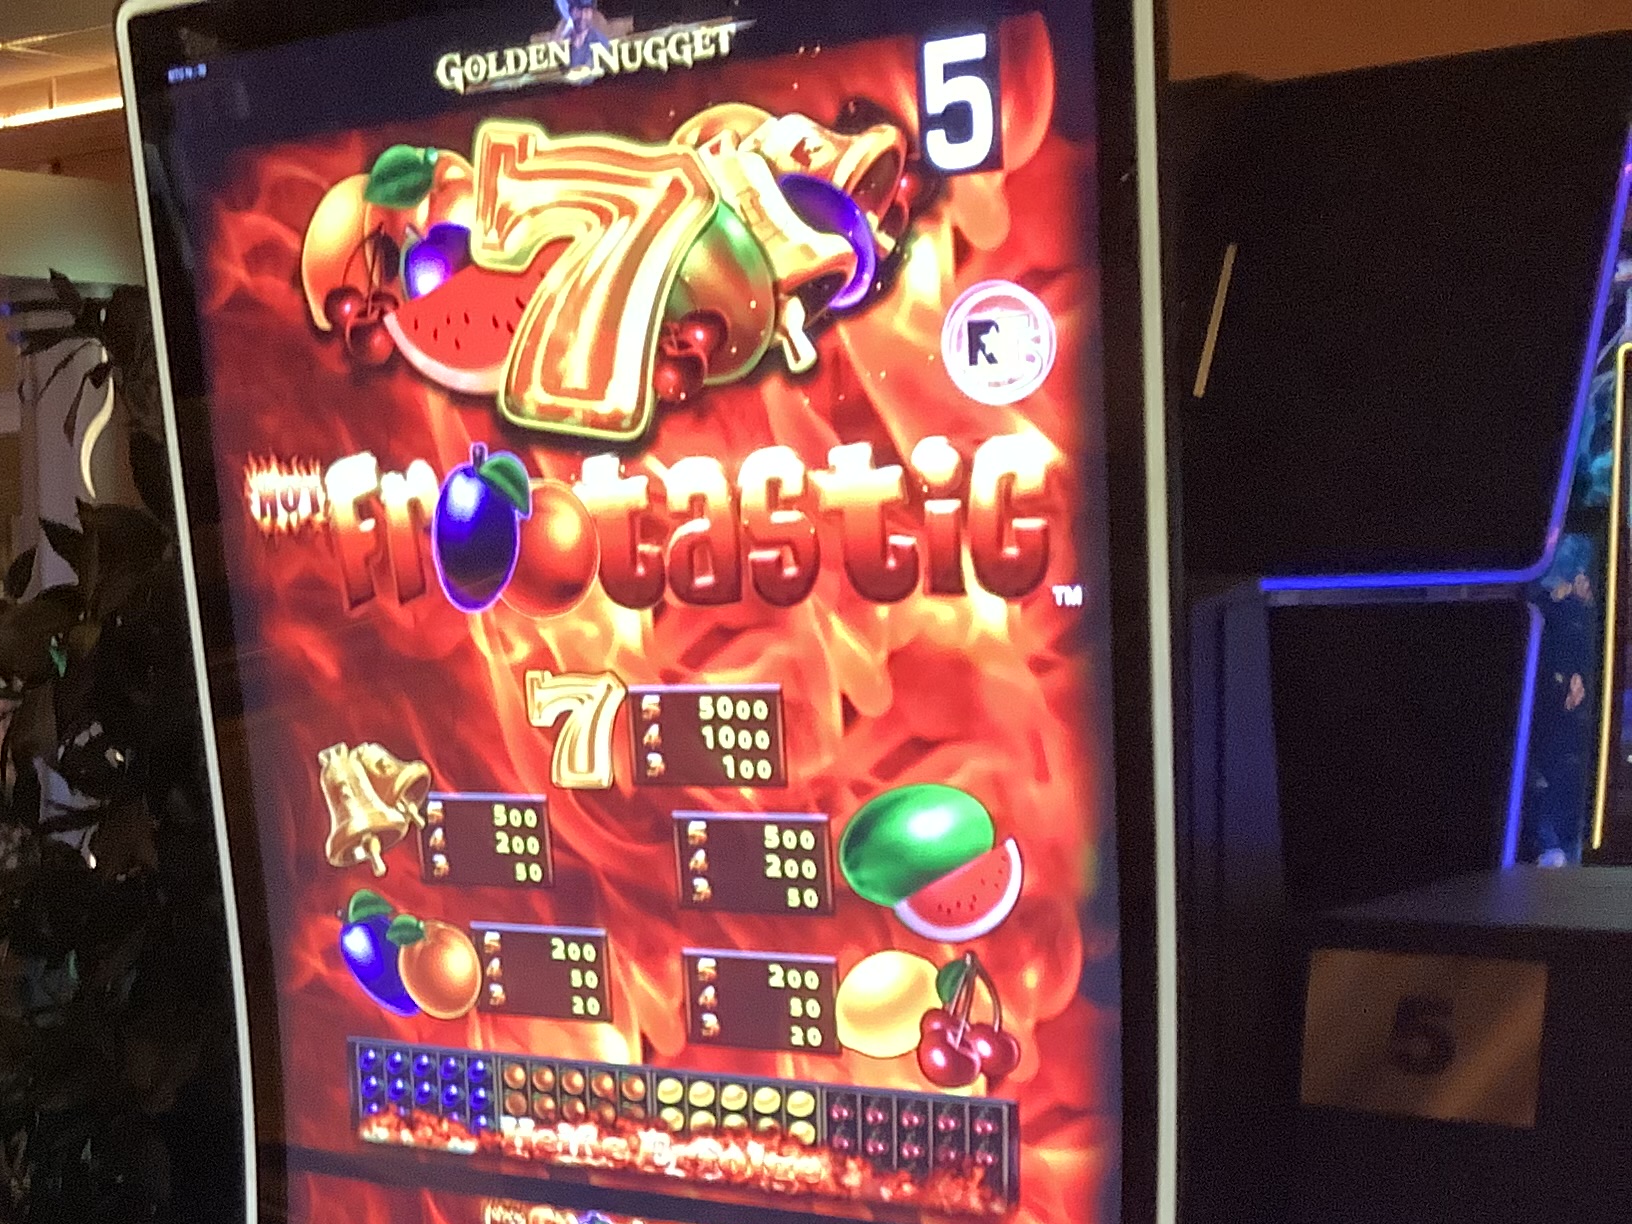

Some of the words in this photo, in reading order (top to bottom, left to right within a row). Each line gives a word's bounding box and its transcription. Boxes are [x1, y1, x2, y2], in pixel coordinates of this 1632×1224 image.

[436, 40, 570, 94] GOLDEN
[590, 24, 736, 77] NUGGET
[923, 33, 993, 170] 5
[699, 696, 768, 720] 5000
[701, 725, 769, 750] 1000
[722, 755, 771, 780] 100
[493, 804, 537, 828] 500
[495, 831, 540, 855] 200
[764, 826, 815, 850] 500
[765, 854, 817, 879] 200
[551, 938, 596, 962] 200
[768, 964, 819, 989] 200
[1390, 993, 1457, 1074] 5
